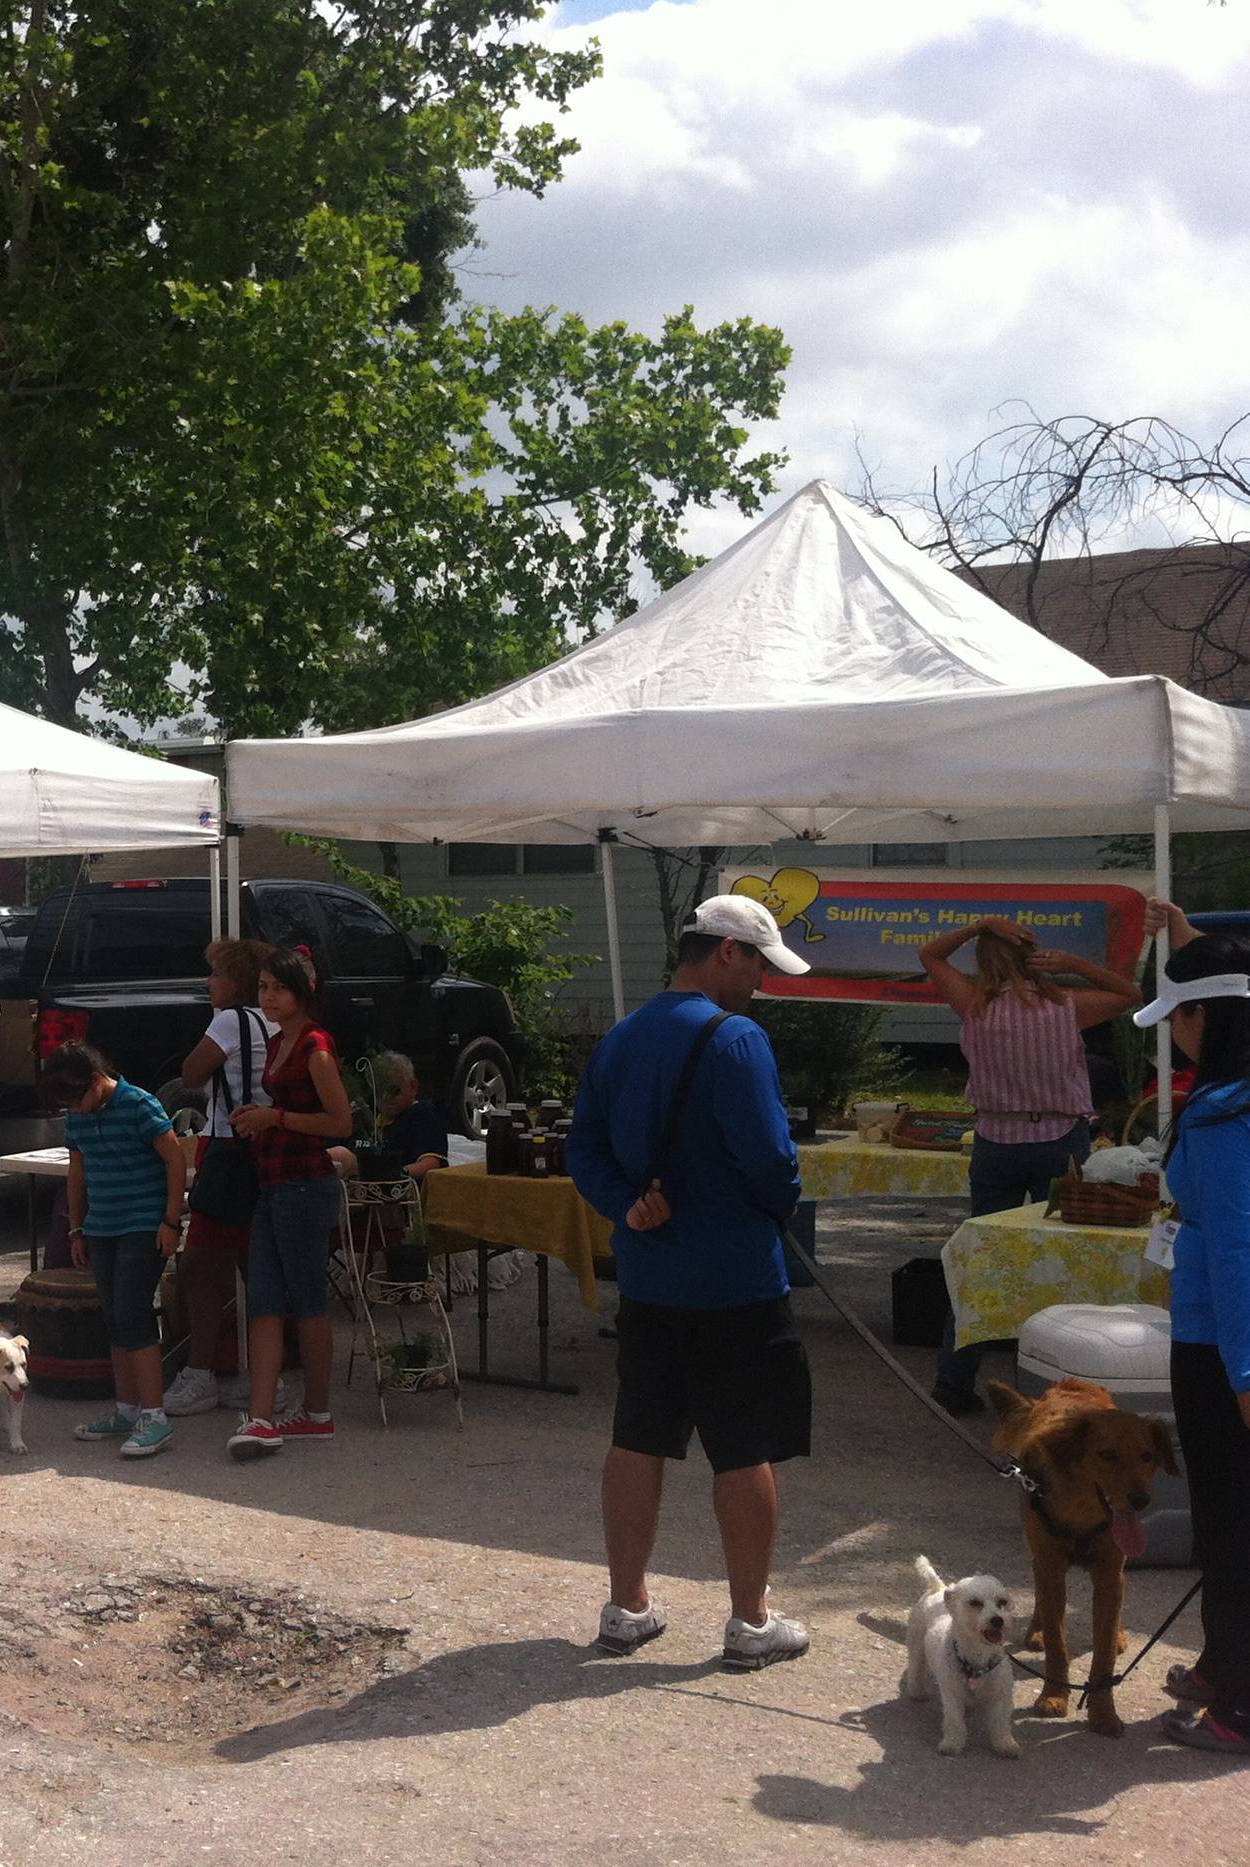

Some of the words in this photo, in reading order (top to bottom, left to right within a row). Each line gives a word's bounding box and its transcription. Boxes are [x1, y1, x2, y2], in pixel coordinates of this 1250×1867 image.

[826, 906, 930, 923] Sullivan's
[1016, 910, 1082, 926] Heart
[880, 929, 942, 944] Famil
